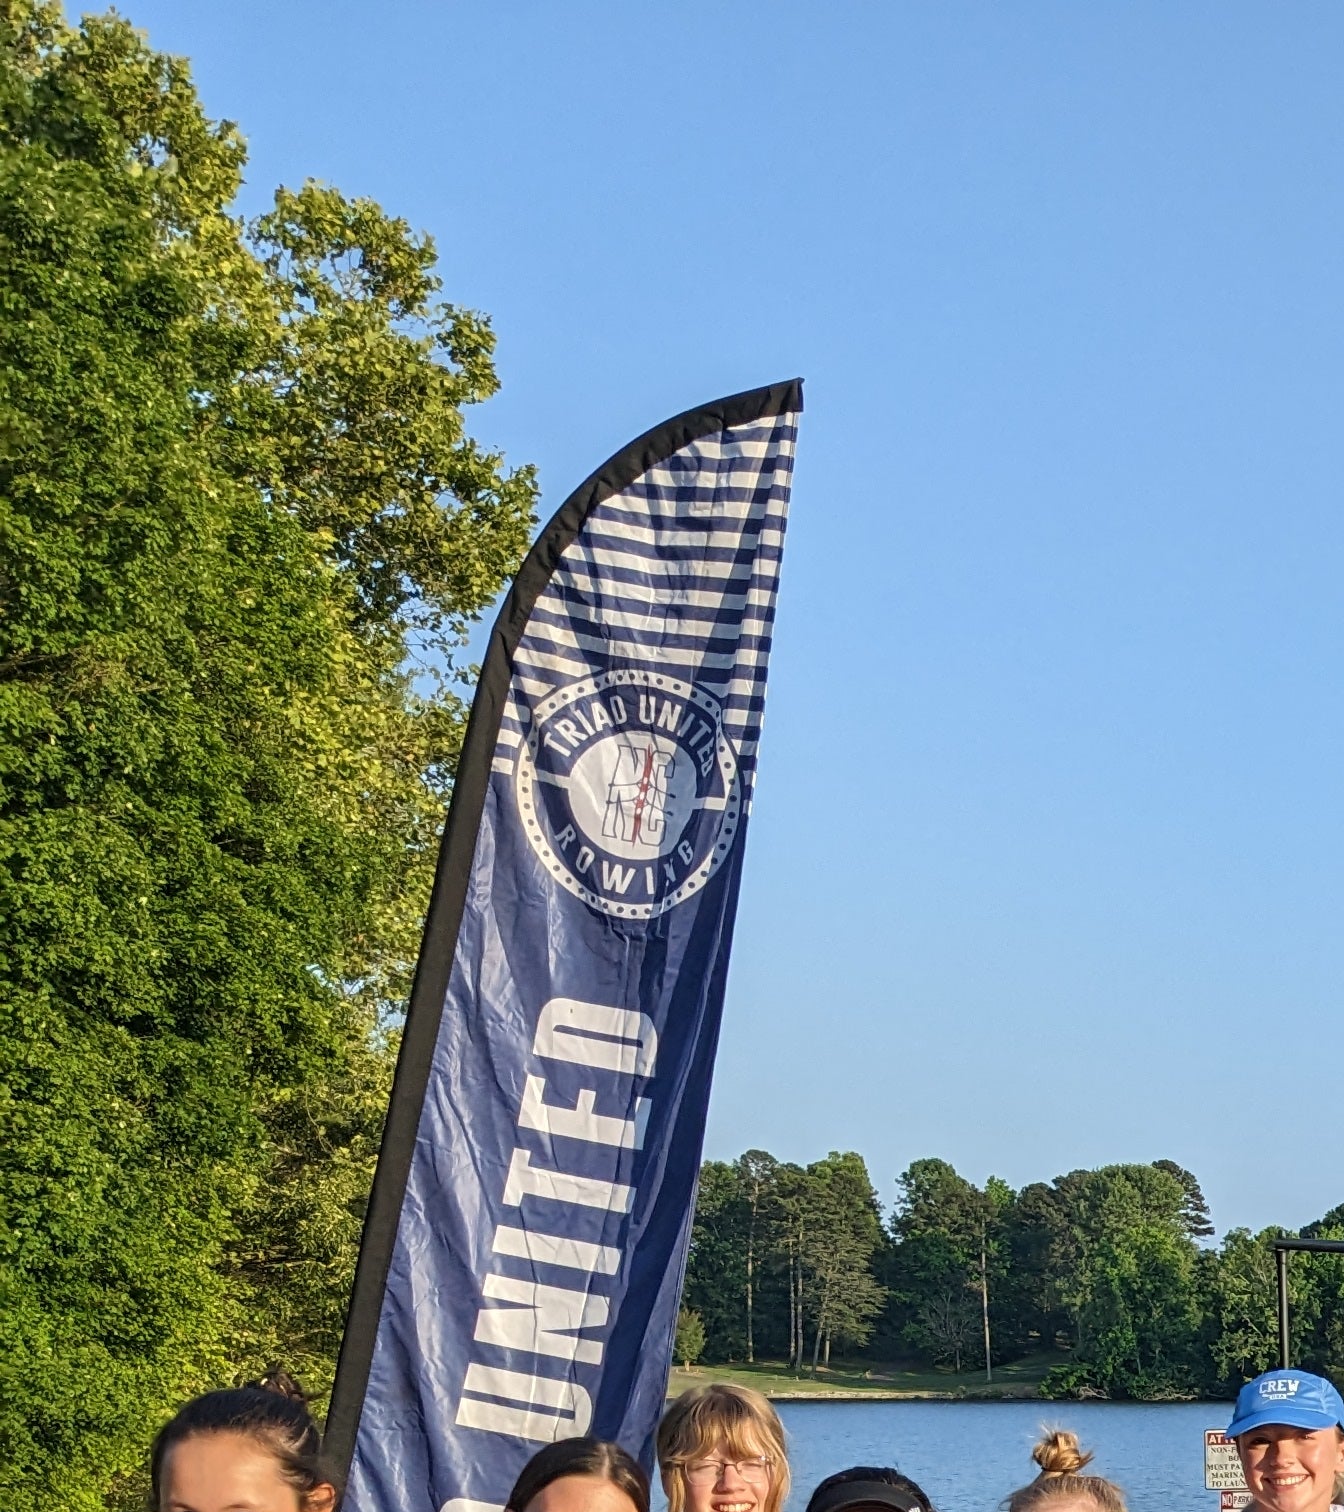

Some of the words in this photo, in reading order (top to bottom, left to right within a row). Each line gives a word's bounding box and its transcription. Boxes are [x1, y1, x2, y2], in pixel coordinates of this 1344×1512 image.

[544, 694, 628, 758] TRIAD
[639, 694, 715, 777] UNITED
[555, 823, 693, 895] ROWING
[456, 997, 659, 1444] UNITED
[1259, 1380, 1299, 1394] CREW
[1222, 1493, 1233, 1507] NO
